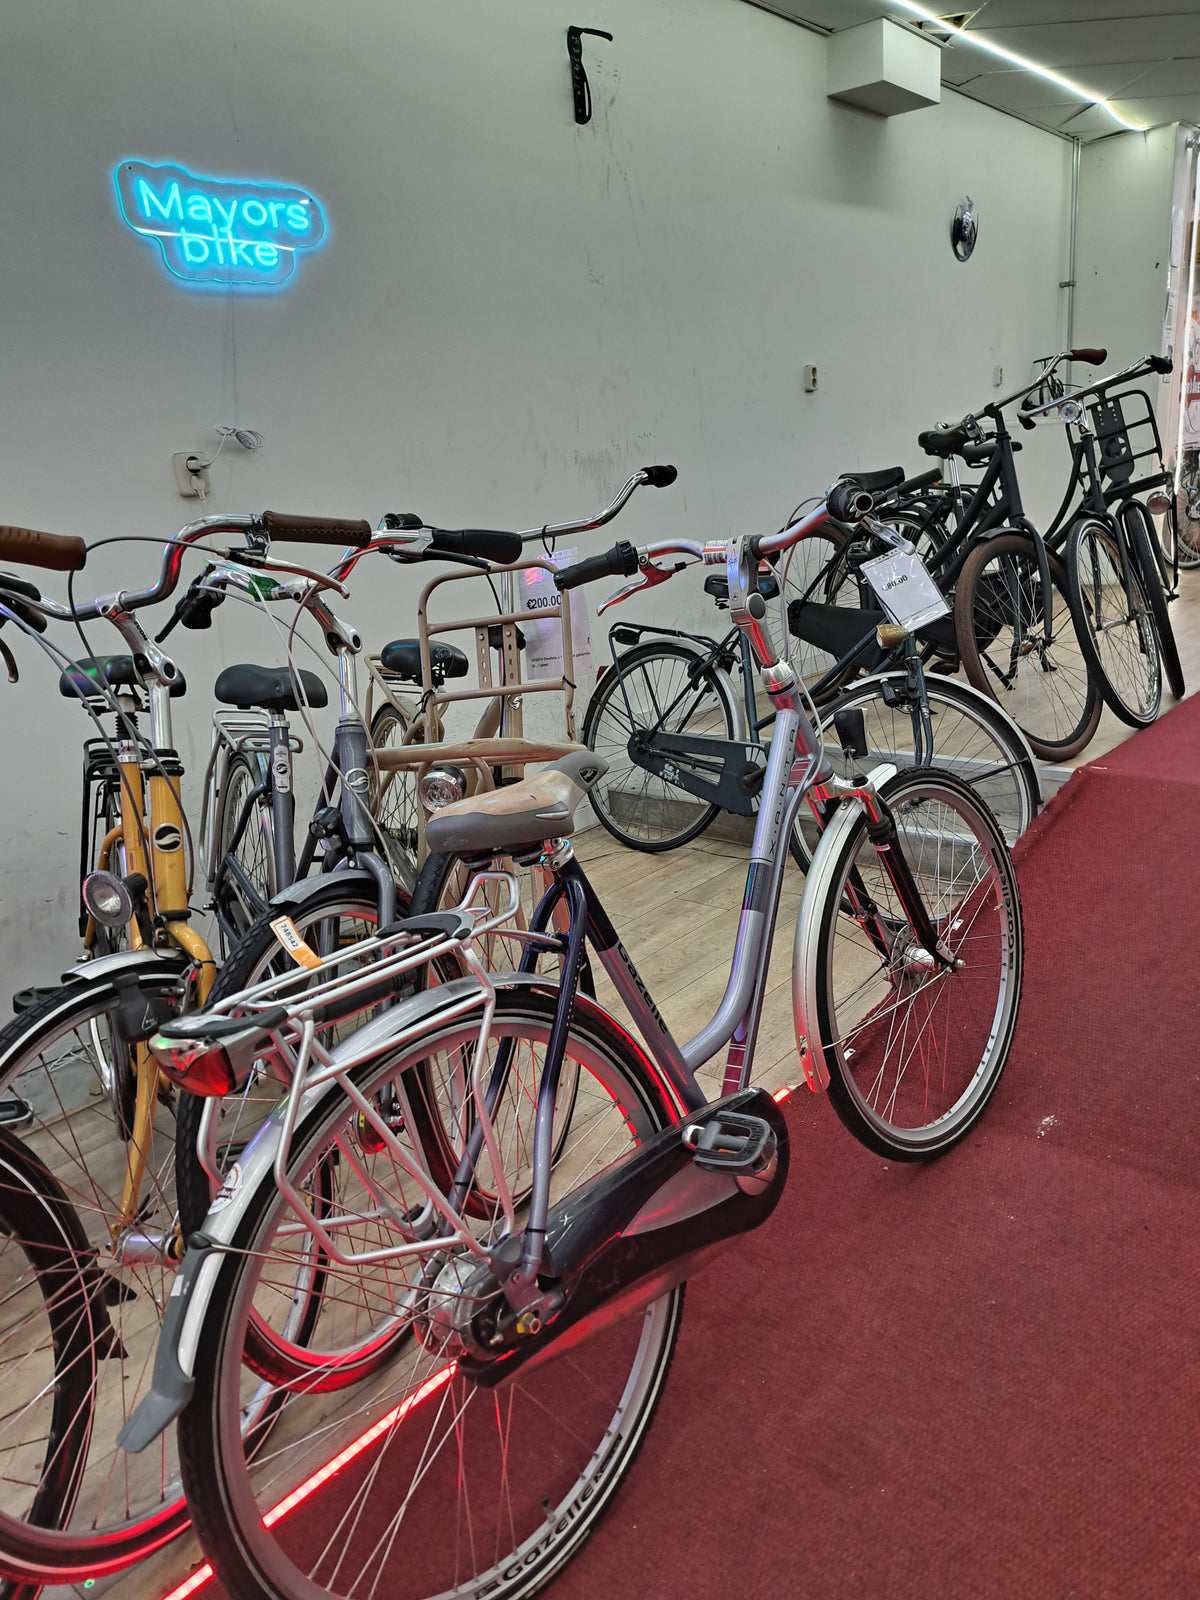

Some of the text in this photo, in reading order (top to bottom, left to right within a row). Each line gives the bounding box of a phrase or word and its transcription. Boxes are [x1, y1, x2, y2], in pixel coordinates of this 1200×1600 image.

[138, 178, 310, 232] Mayors
[180, 222, 279, 266] bike
[280, 923, 299, 948] 748542
[1001, 877, 1015, 950] Gazelle
[618, 942, 668, 1034] Gazelle
[502, 1483, 594, 1582] Gazelle
